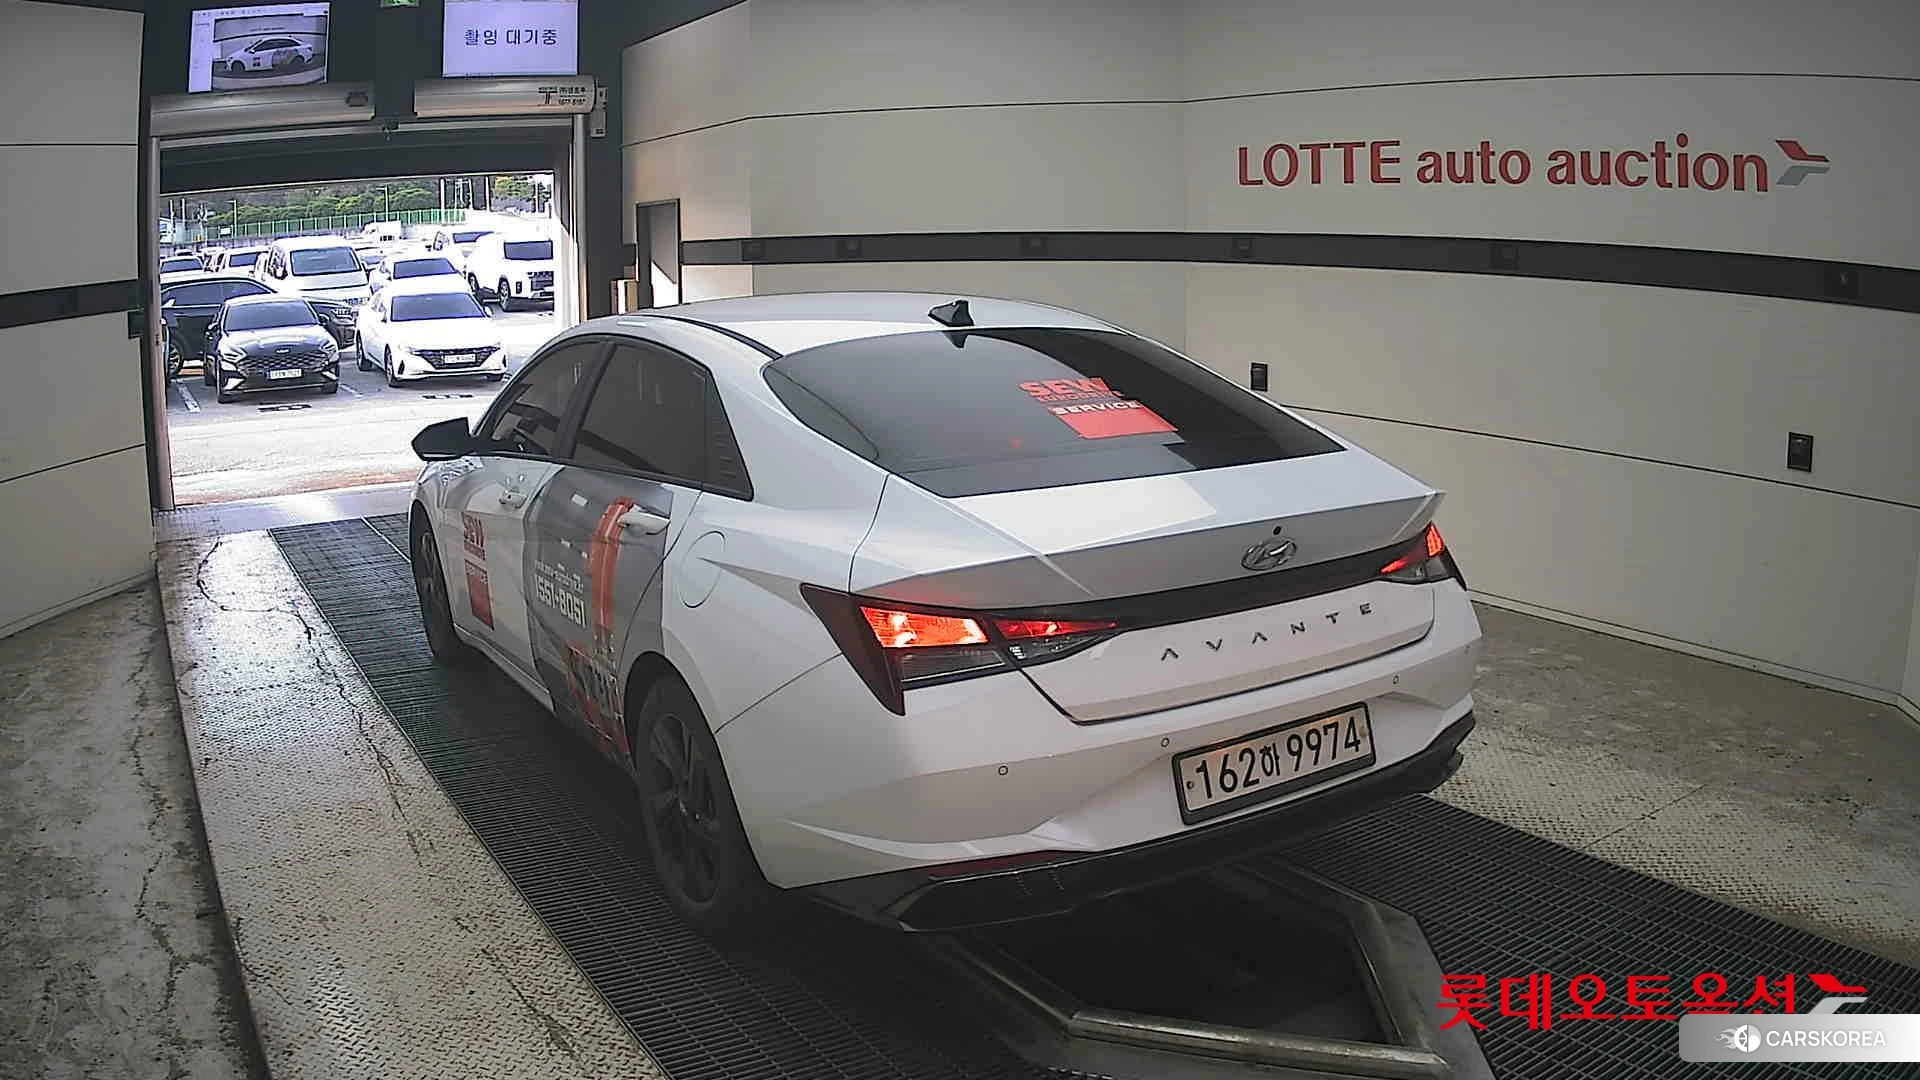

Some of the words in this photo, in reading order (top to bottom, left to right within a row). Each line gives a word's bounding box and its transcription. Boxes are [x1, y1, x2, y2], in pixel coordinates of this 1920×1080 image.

[464, 29, 497, 46] 촬영
[506, 28, 557, 46] 대기중
[1238, 140, 1401, 186] LOTTE
[1416, 140, 1532, 185] auto
[1546, 133, 1768, 193] auction
[1052, 402, 1141, 415] SERVICE
[1161, 602, 1373, 661] AVANTE
[1196, 743, 1280, 799] 162하
[1287, 716, 1361, 772] 9974
